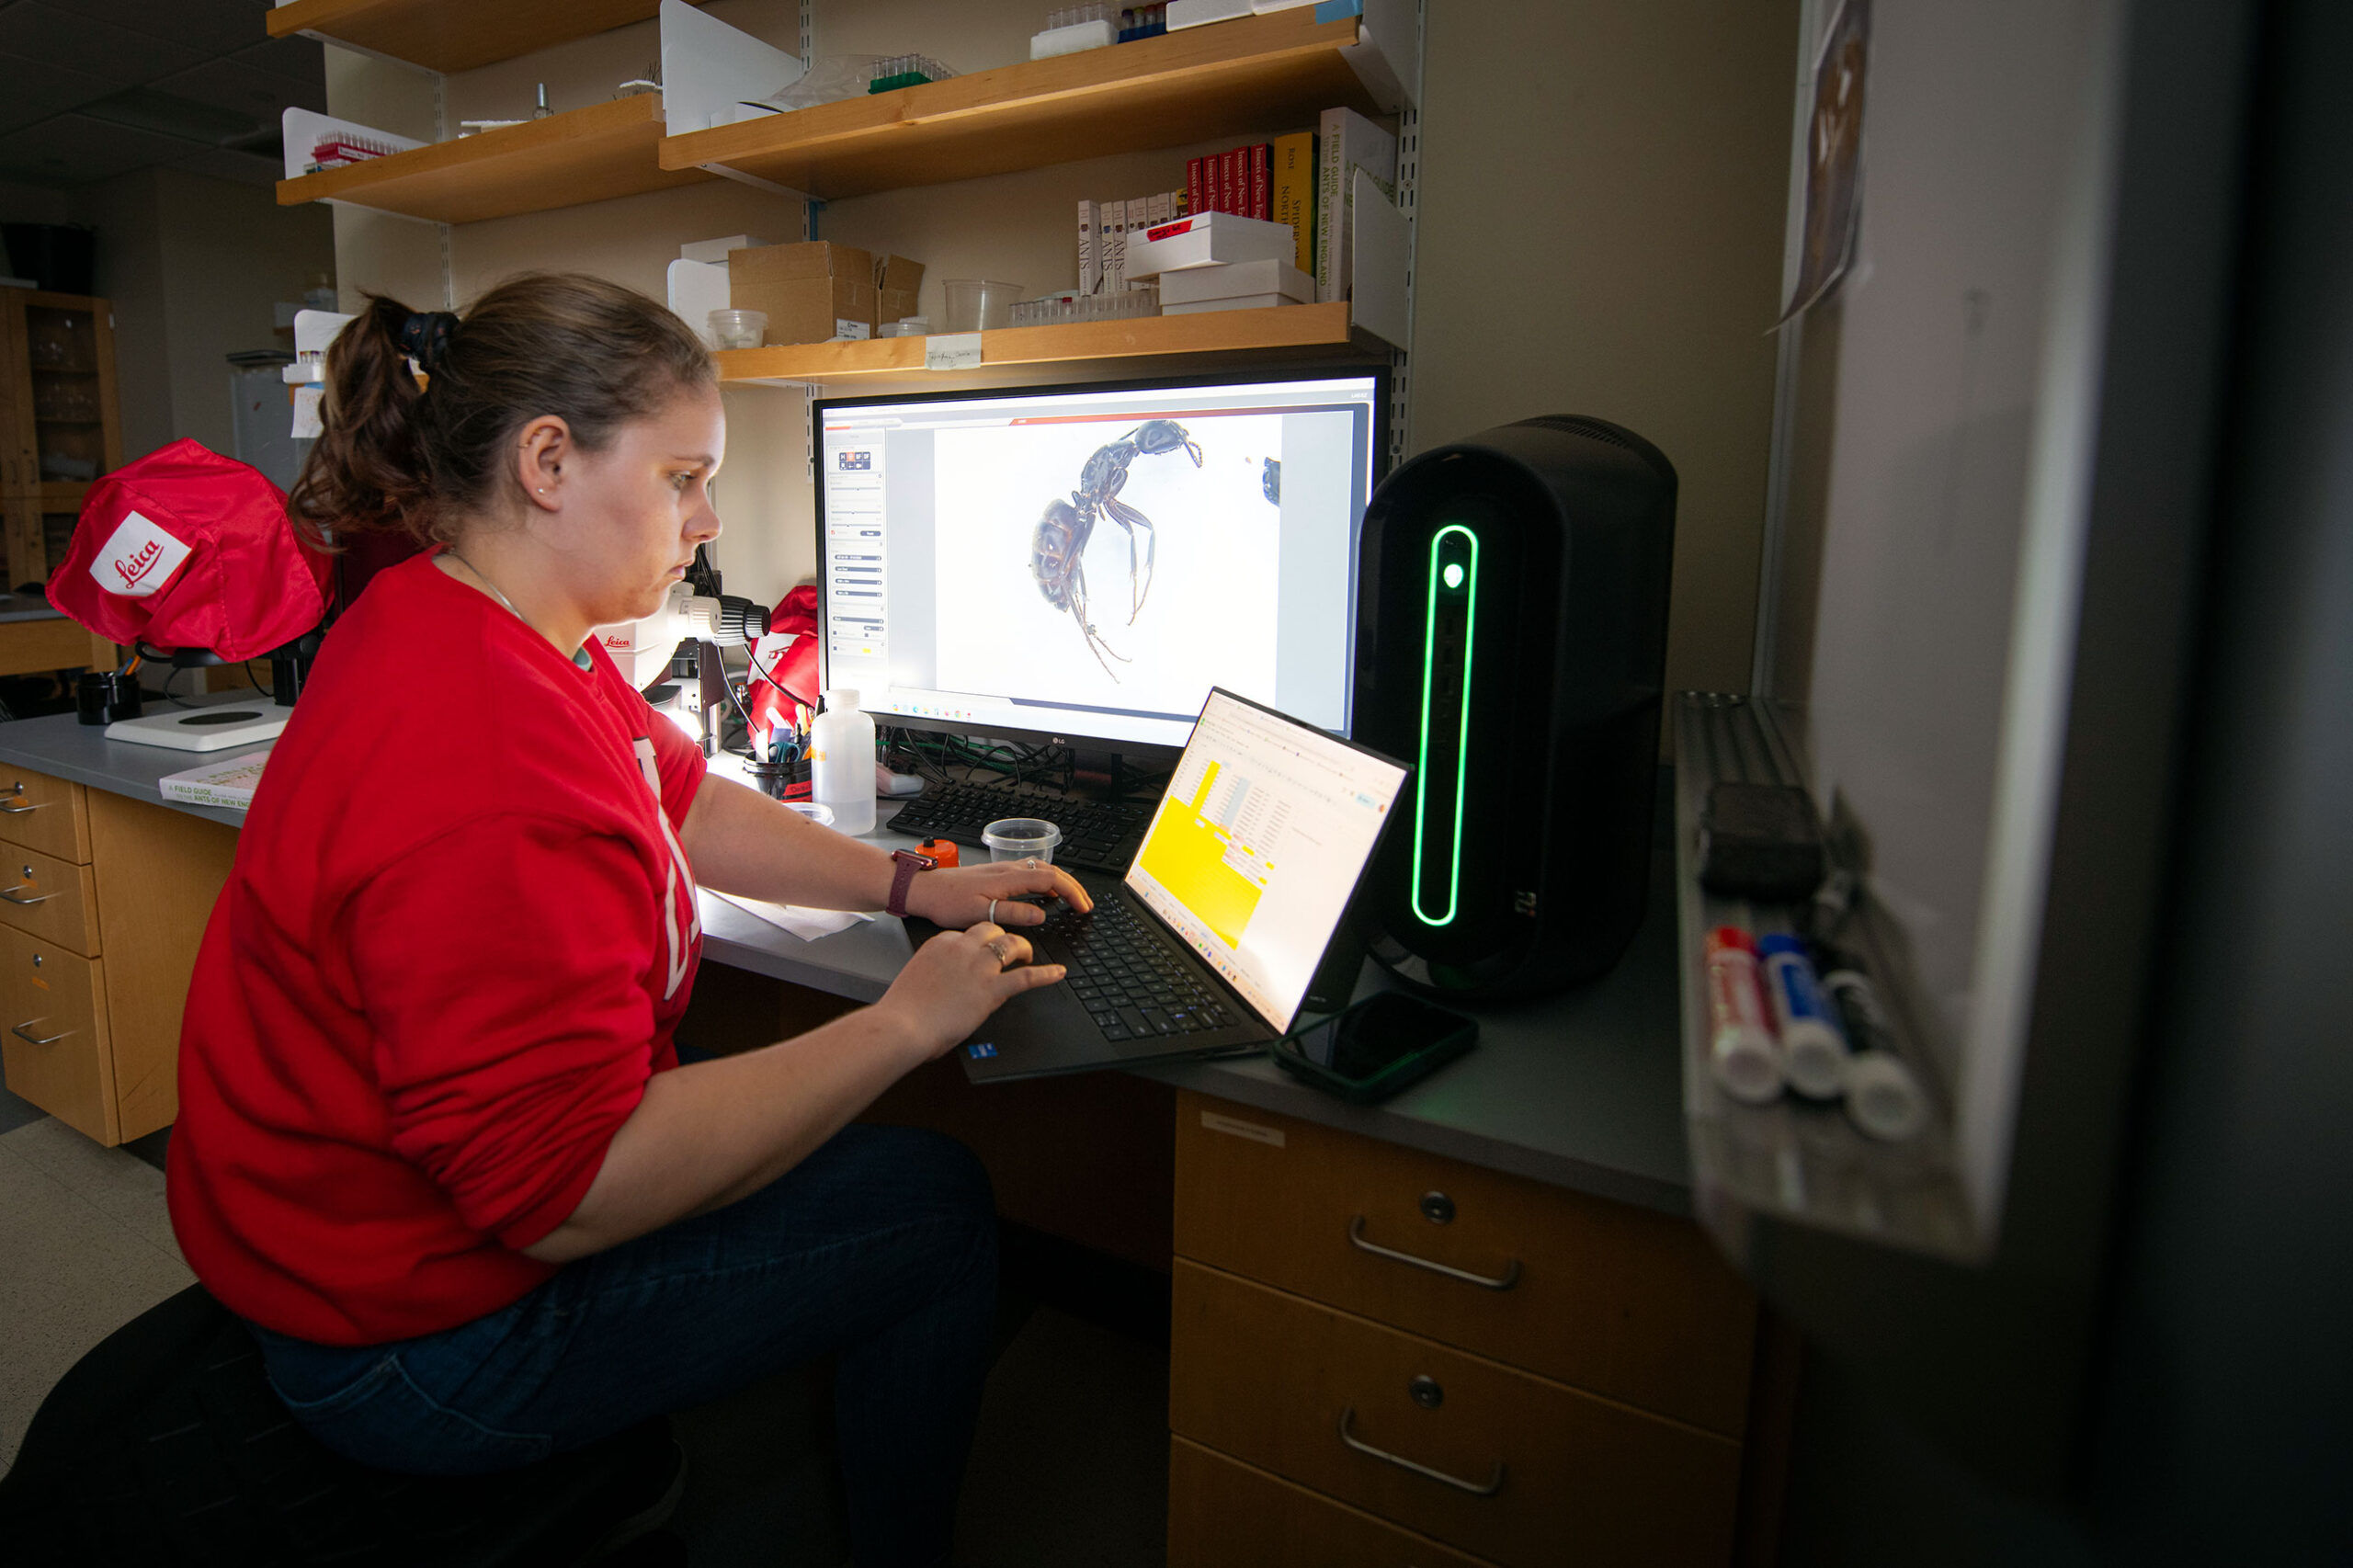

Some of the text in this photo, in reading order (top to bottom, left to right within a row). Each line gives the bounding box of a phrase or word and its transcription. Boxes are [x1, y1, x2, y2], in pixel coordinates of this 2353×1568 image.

[1223, 155, 1232, 181] Insects
[1237, 151, 1245, 176] Insects
[1255, 147, 1263, 174] Insects
[1329, 124, 1340, 198] A FIELD GUIDE
[1207, 159, 1215, 185] Insects
[1237, 177, 1246, 187] of
[1256, 174, 1264, 184] of
[1322, 165, 1330, 194] ANTS
[1191, 188, 1199, 197] of
[1208, 186, 1216, 194] of
[1224, 182, 1233, 190] of
[1238, 187, 1246, 205] New
[1256, 184, 1264, 202] New
[1224, 191, 1233, 210] New
[1321, 196, 1329, 211] OF
[1320, 213, 1328, 237] NEW
[1079, 238, 1090, 270] ANTS
[1102, 240, 1113, 272] ANTS
[1114, 239, 1125, 271] ANTS
[1318, 239, 1328, 287] ENGLAND
[114, 540, 165, 589] Leica
[603, 635, 631, 648] Leica
[174, 785, 192, 794] FIELD
[193, 787, 212, 796] GUIDE
[193, 794, 210, 803] ANTS
[221, 798, 236, 806] NEW
